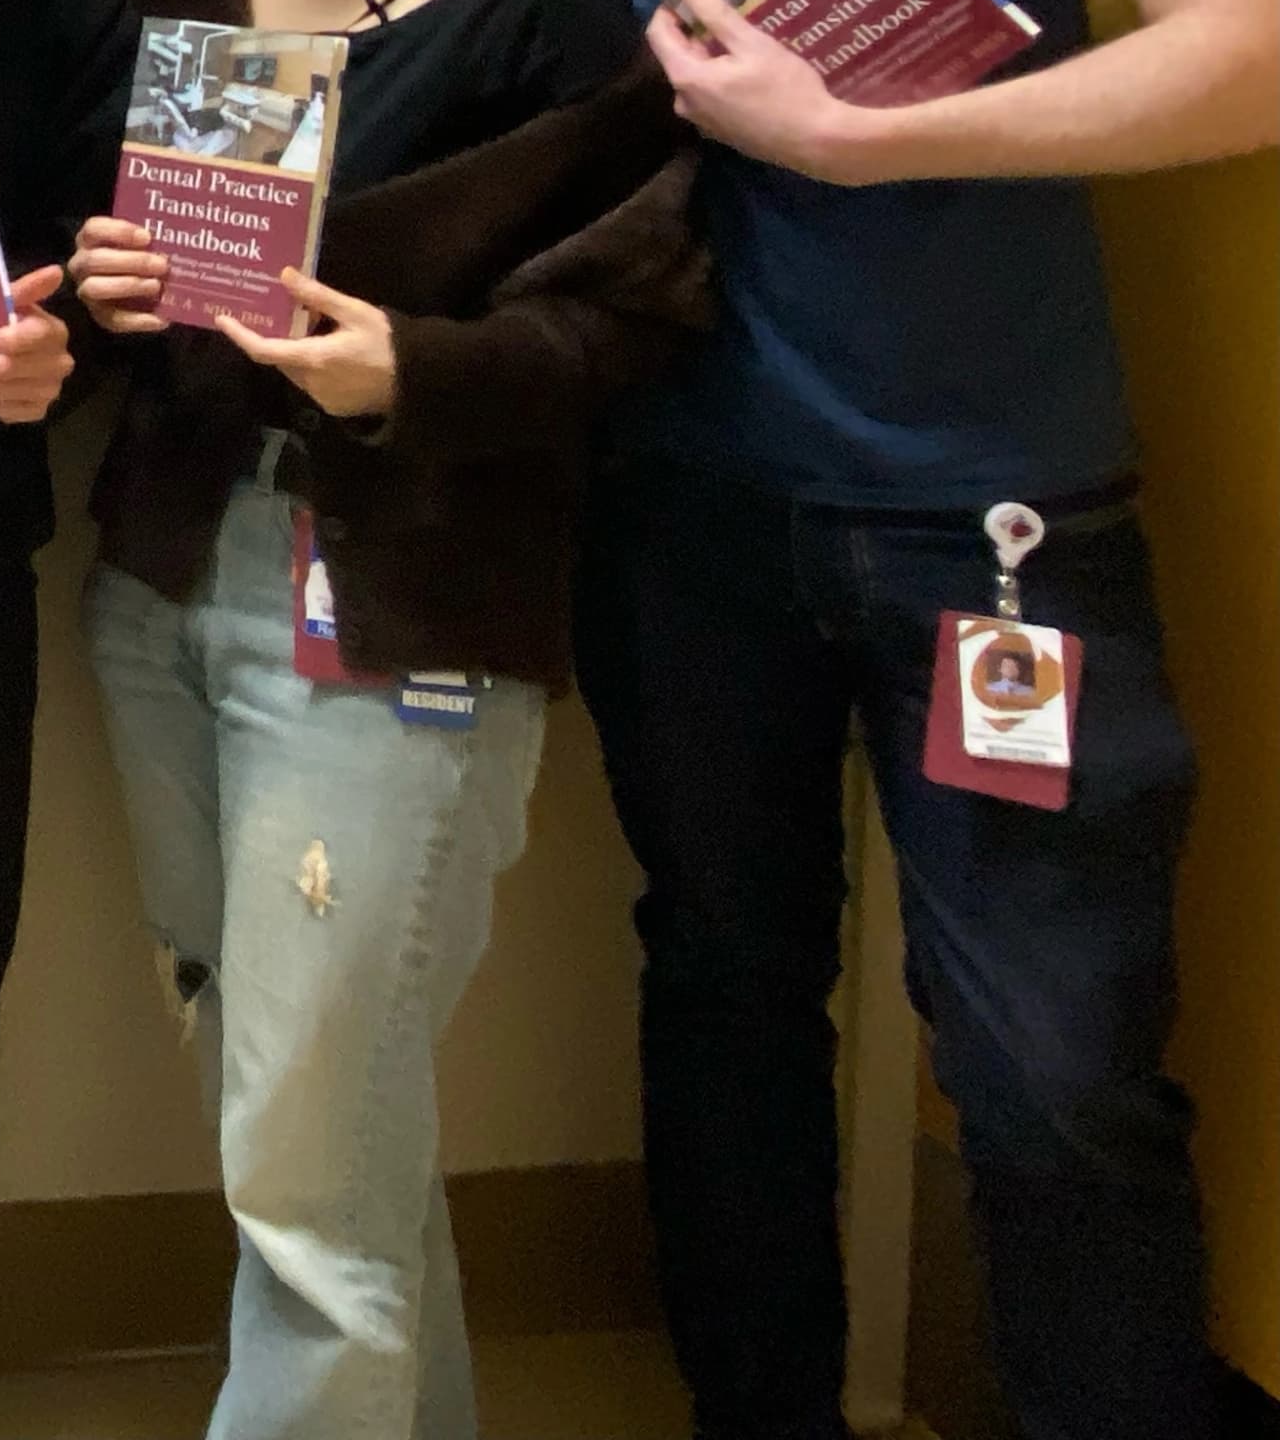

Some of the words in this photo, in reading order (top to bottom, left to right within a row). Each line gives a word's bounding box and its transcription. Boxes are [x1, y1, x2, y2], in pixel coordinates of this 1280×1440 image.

[126, 157, 202, 188] Dental
[208, 171, 299, 204] Practice
[144, 188, 271, 230] Transitions
[143, 218, 263, 260] Handbook
